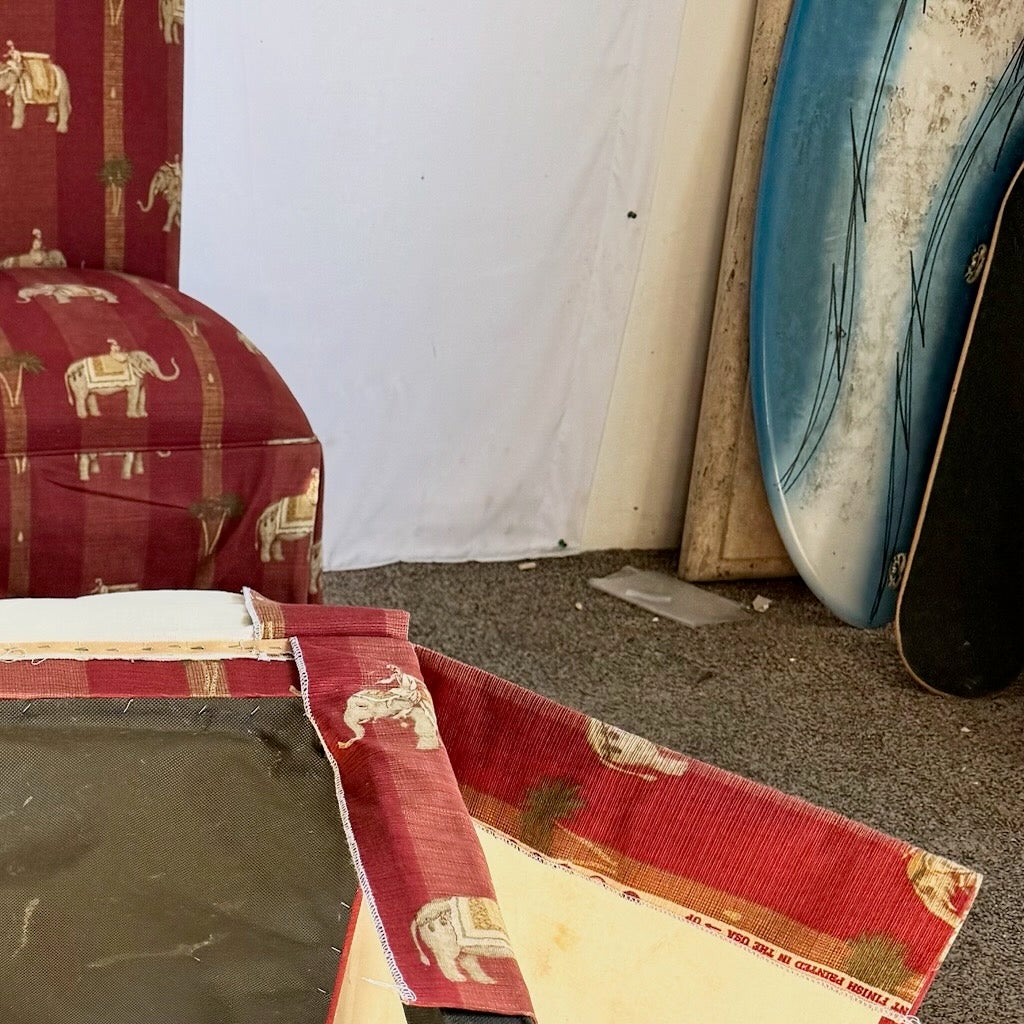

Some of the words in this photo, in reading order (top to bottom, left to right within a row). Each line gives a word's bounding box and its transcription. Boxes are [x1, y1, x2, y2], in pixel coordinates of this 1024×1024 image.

[726, 929, 751, 946] USA
[751, 941, 775, 958] THE
[777, 953, 792, 965] IN
[794, 960, 846, 986] PRINTED
[846, 981, 890, 1006] FINISH
